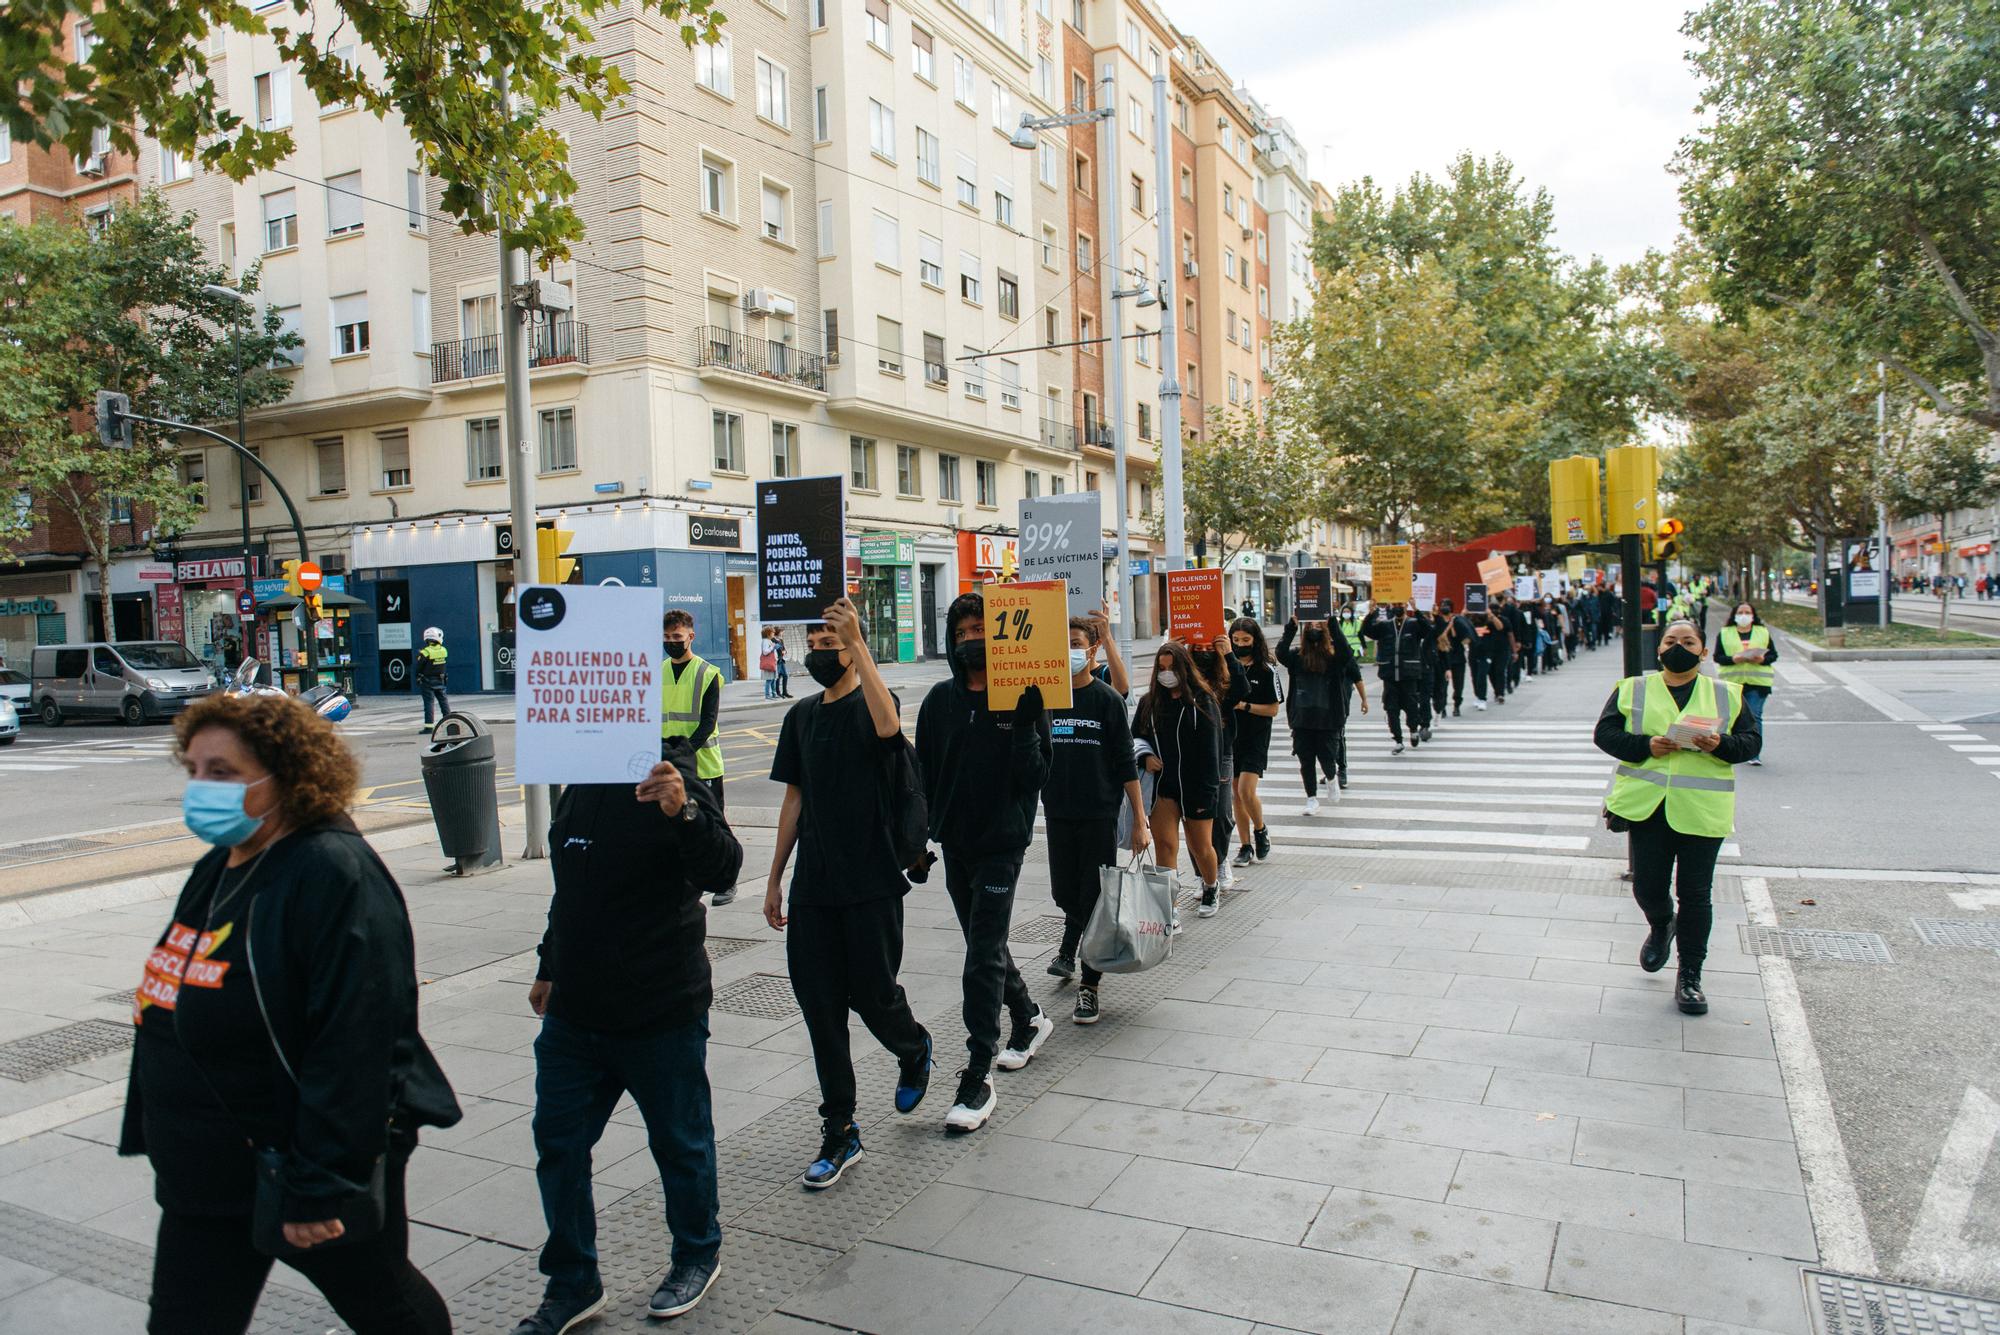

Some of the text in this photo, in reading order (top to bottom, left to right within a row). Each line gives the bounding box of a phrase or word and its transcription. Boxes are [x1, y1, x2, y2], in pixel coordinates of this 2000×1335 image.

[704, 526, 738, 538] carlosreula
[1023, 520, 1073, 553] 99%
[766, 533, 803, 546] JUNTOS,
[766, 546, 808, 559] PODEMOS
[766, 559, 823, 573] ACABAR CON
[1024, 552, 1099, 567] DE LAS VÍCTIMAS
[178, 562, 222, 580] BELLA
[1053, 571, 1072, 580] SON
[767, 573, 821, 586] LA TRATA DE
[1171, 575, 1208, 583] ABOLIENDO
[767, 587, 817, 600] PERSONAS.
[1172, 584, 1211, 593] ESCLAVITUD
[668, 593, 703, 602] carlosreula
[989, 596, 1031, 608] SÓLO EL
[992, 608, 1033, 642] 1%
[1174, 622, 1205, 630] SIEMPRE.
[991, 645, 1028, 655] DE LAS
[531, 651, 648, 668] ABOLIENDO LA
[992, 658, 1065, 671] VÍCTIMAS SON
[527, 670, 652, 686] ESCLAVITUD EN
[993, 675, 1063, 687] RESCATADAS.
[533, 688, 646, 705] TODO LUGAR Y
[527, 707, 651, 724] PARA SIEMPRE.
[1052, 718, 1102, 730] OWERADE
[1138, 920, 1163, 935] ZARA
